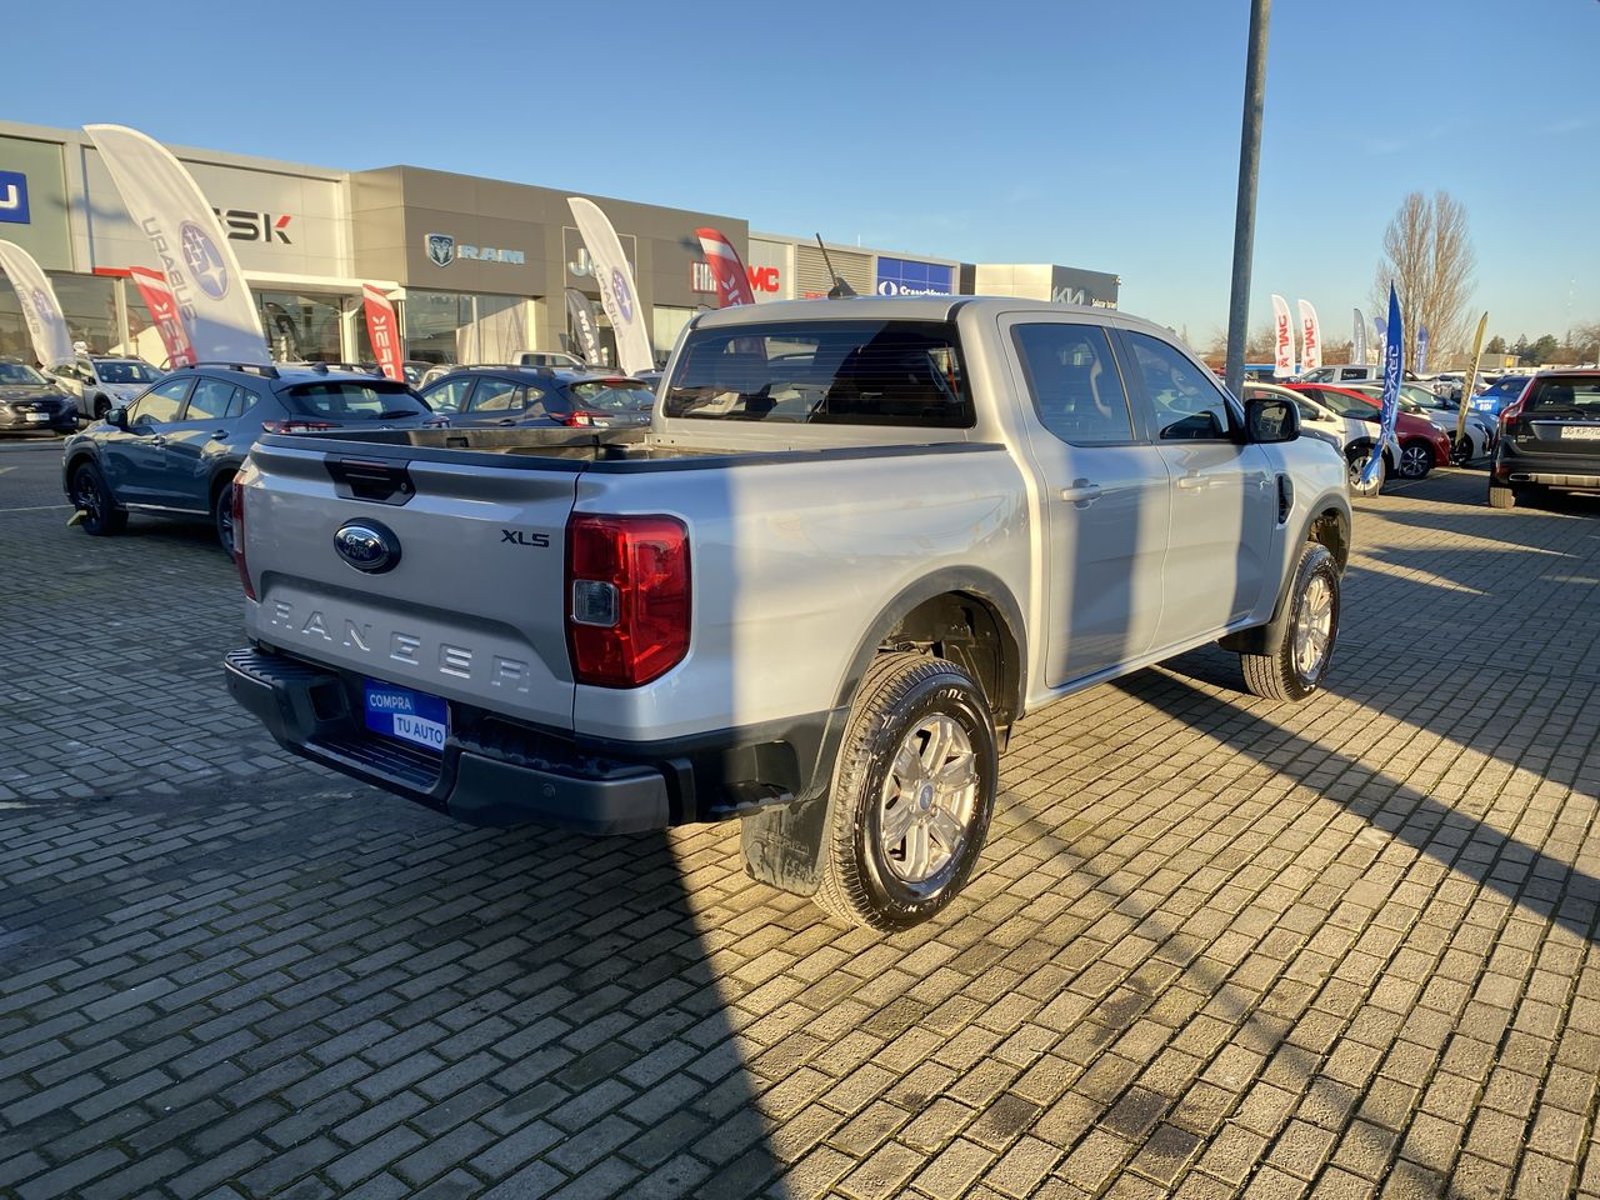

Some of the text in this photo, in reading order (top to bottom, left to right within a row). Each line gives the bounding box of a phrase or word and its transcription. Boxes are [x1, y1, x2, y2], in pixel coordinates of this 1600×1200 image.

[212, 207, 292, 244] SK
[457, 245, 525, 265] RAM
[747, 265, 780, 292] MC
[501, 529, 550, 548] XLS
[271, 599, 531, 693] RANGER
[369, 693, 413, 712] COMPRA
[397, 716, 443, 745] TU AUTO
